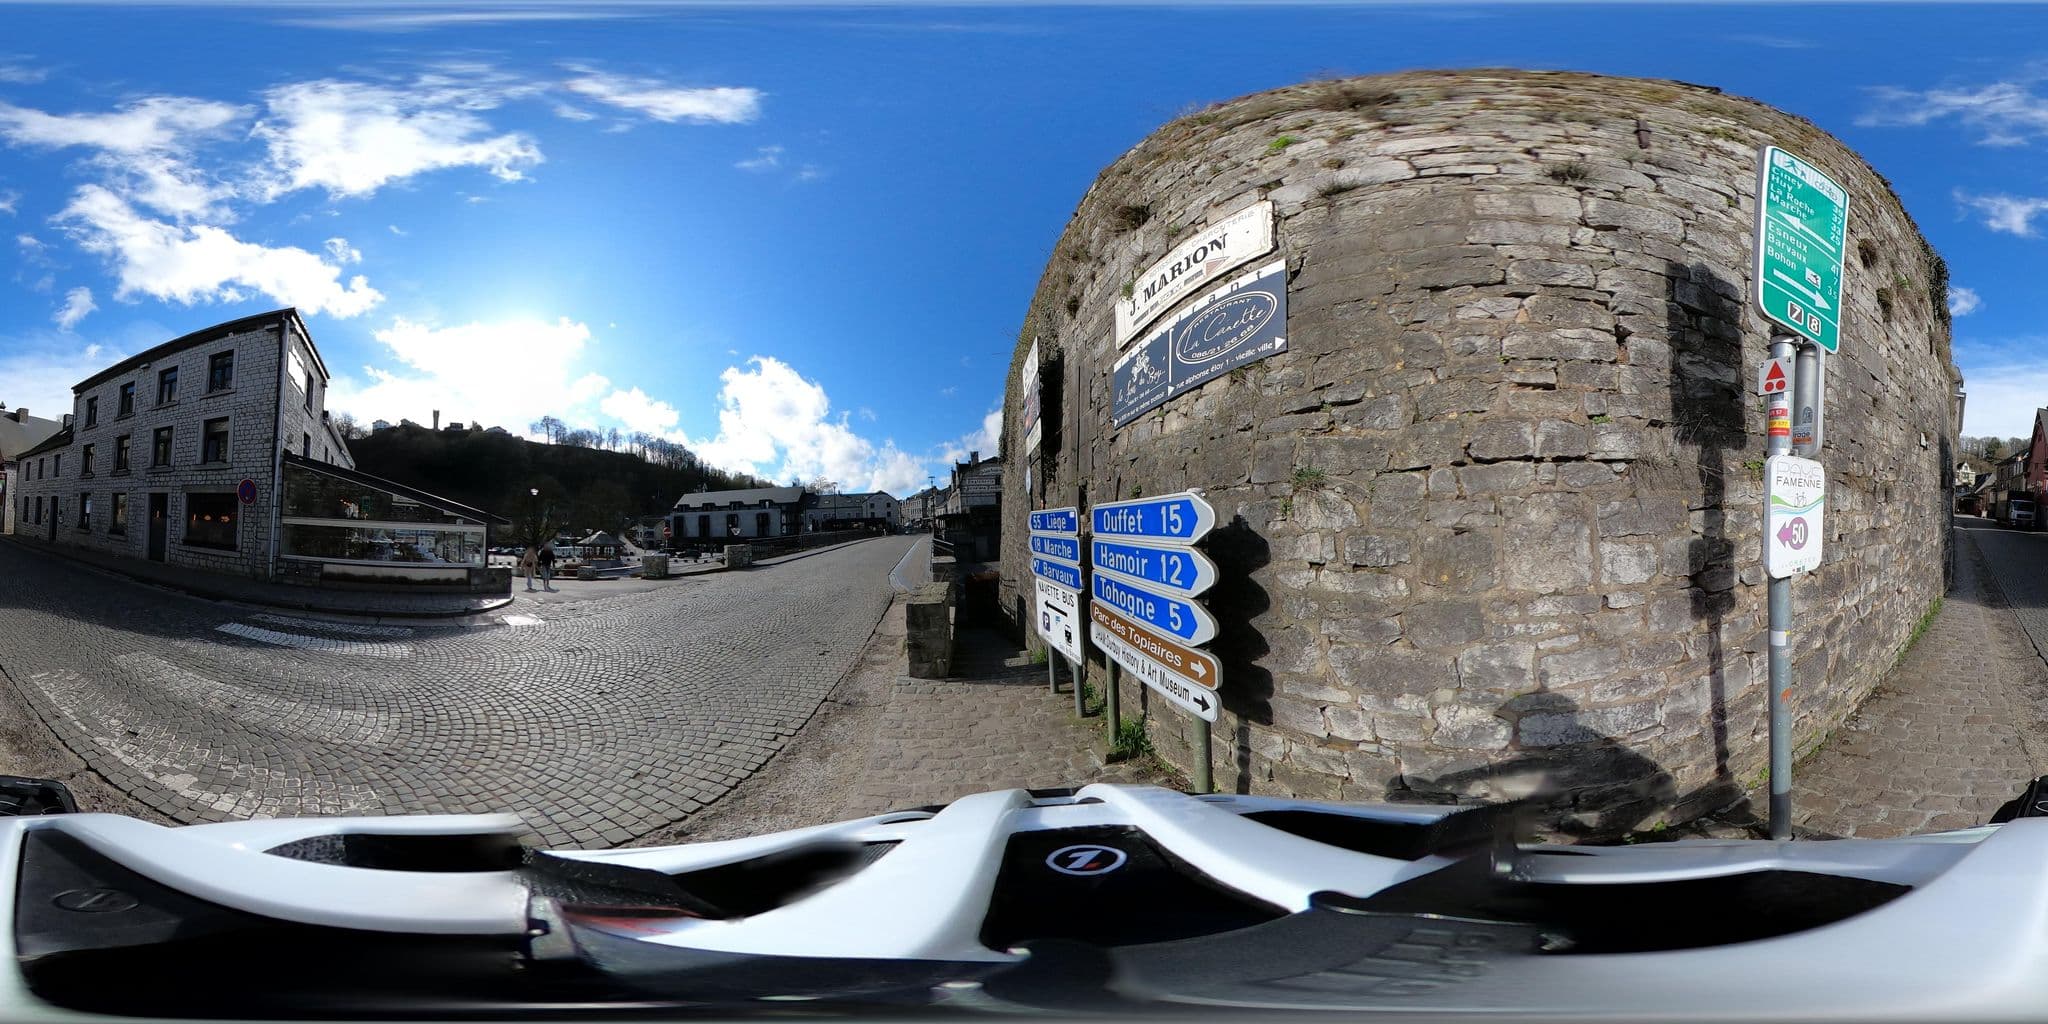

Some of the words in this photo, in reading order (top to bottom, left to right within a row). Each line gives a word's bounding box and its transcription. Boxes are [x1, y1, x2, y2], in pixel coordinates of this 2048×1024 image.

[1771, 173, 1792, 193] Huy
[1772, 166, 1803, 189] Ciney
[1770, 183, 1783, 196] La
[1786, 193, 1815, 216] Roche
[1769, 192, 1807, 221] Marche
[1830, 232, 1841, 246] 25
[1767, 233, 1807, 265] Barvaux
[1767, 245, 1797, 271] Bohon
[1768, 221, 1808, 254] Esneux
[1830, 264, 1839, 277] 41
[1129, 298, 1141, 317] J.
[1142, 233, 1229, 304] MARION
[1791, 306, 1800, 319] 7
[1810, 318, 1818, 332] 8
[1257, 342, 1273, 353] ville
[1776, 475, 1822, 489] FAMENNE
[1032, 514, 1042, 529] 55
[1046, 512, 1067, 533] Liège
[1103, 508, 1143, 534] Ouffet
[1160, 503, 1183, 535] 15
[1792, 523, 1805, 545] 50
[1034, 537, 1041, 552] 18
[1043, 538, 1072, 559] Marche
[1043, 561, 1074, 586] Barvaux
[1100, 545, 1149, 577] Hamoir
[1160, 554, 1183, 586] 12
[1037, 581, 1060, 601] NAVETTE
[1061, 591, 1075, 608] BUS
[1099, 577, 1155, 620] Tohogne
[1169, 602, 1183, 632] 5
[1093, 607, 1110, 627] Parc
[1110, 616, 1127, 637] des
[1128, 626, 1183, 667] Topiaires
[1121, 646, 1139, 674] History
[1140, 659, 1146, 675] &
[1147, 663, 1157, 683] Art
[1159, 669, 1191, 703] Museum
